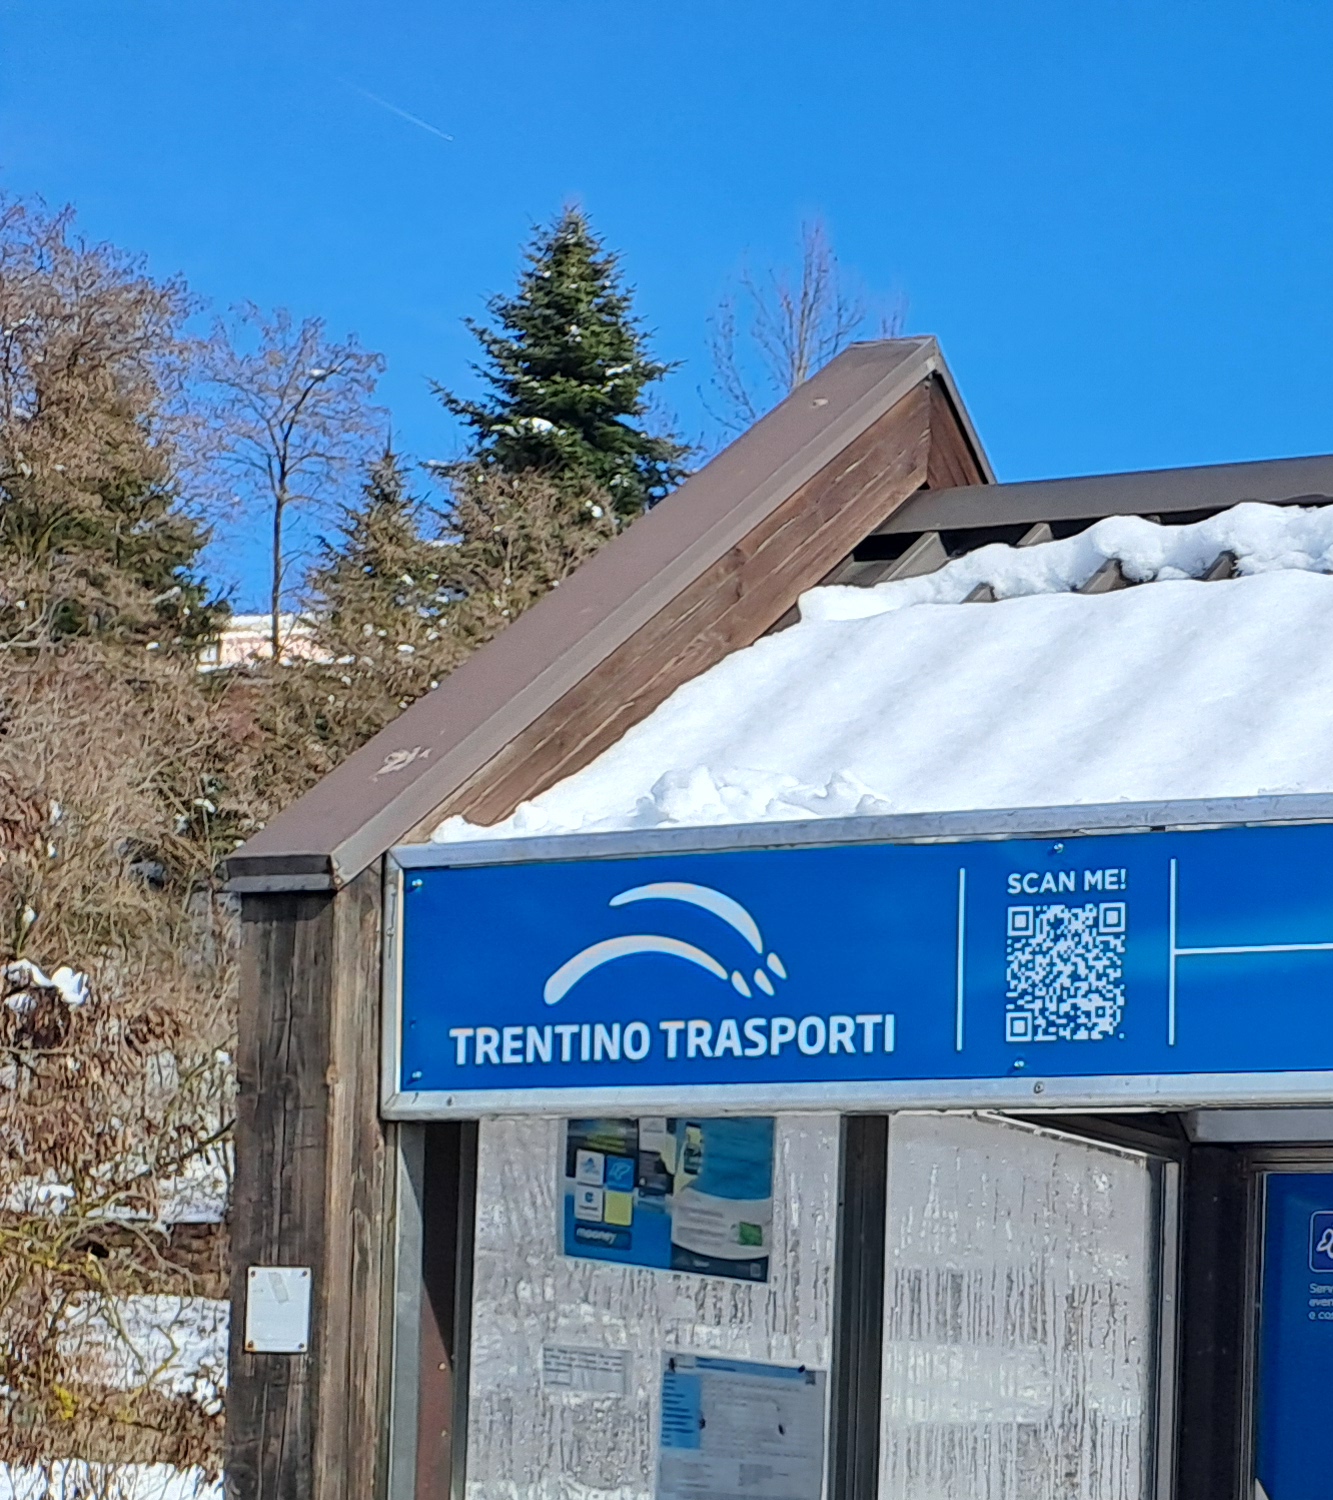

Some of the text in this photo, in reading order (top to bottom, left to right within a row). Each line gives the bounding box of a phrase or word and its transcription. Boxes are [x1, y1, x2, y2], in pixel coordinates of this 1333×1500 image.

[1006, 869, 1127, 895] SCAN ME!
[449, 1012, 896, 1066] TRENTINO TRASPORTI
[1309, 1312, 1316, 1320] e
